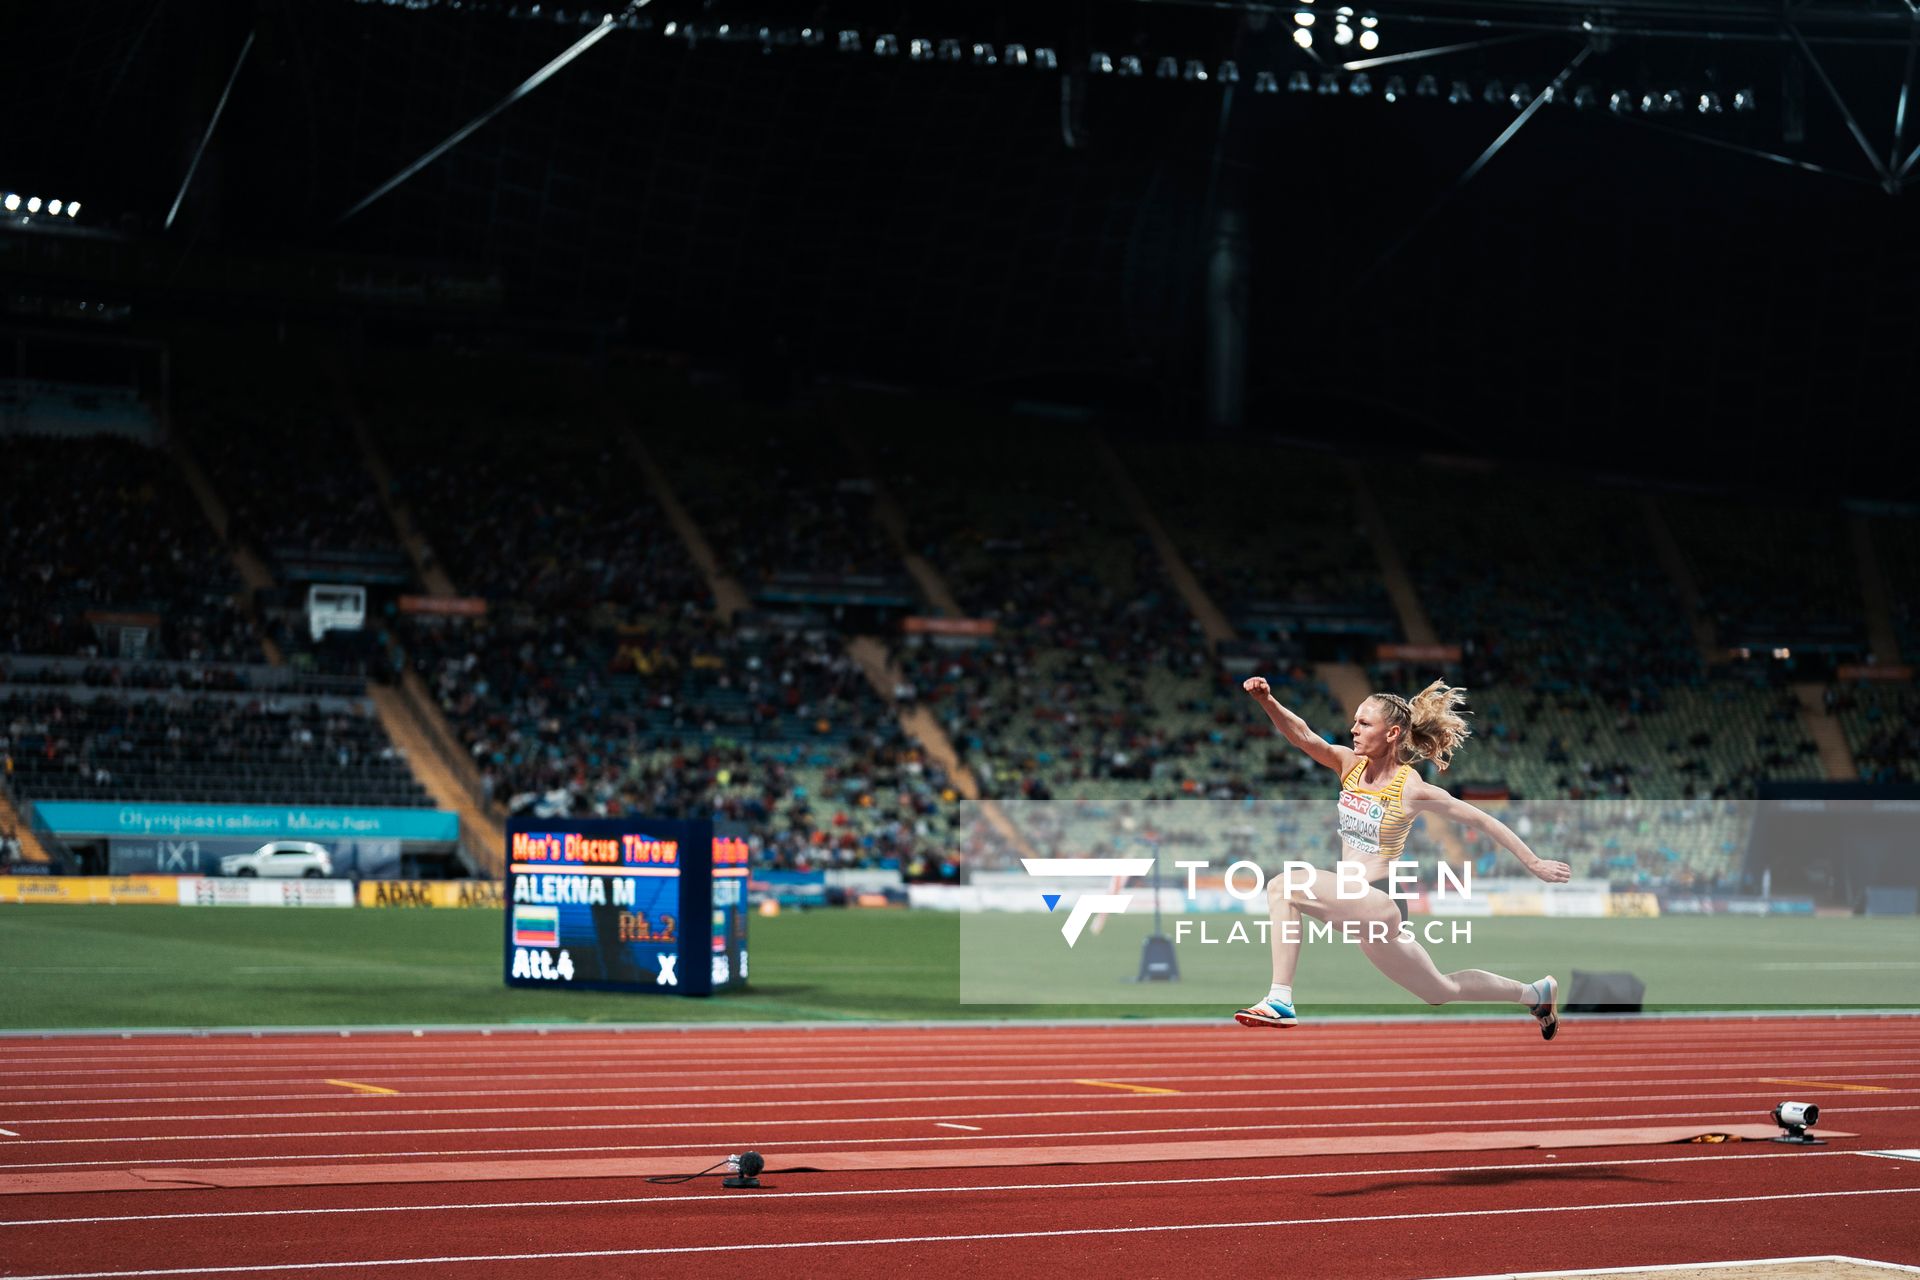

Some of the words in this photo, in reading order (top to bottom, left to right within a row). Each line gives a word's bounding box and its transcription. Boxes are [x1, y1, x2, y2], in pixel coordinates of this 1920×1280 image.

[1340, 793, 1370, 813] SPAR
[512, 832, 561, 861] Men's
[564, 833, 619, 863] Discus
[622, 834, 679, 864] Throw
[375, 880, 433, 908] ADAC
[458, 881, 505, 909] ADA
[512, 875, 607, 906] ALEKNA
[612, 877, 637, 906] M
[511, 948, 575, 981] Att.4
[656, 952, 679, 986] X
